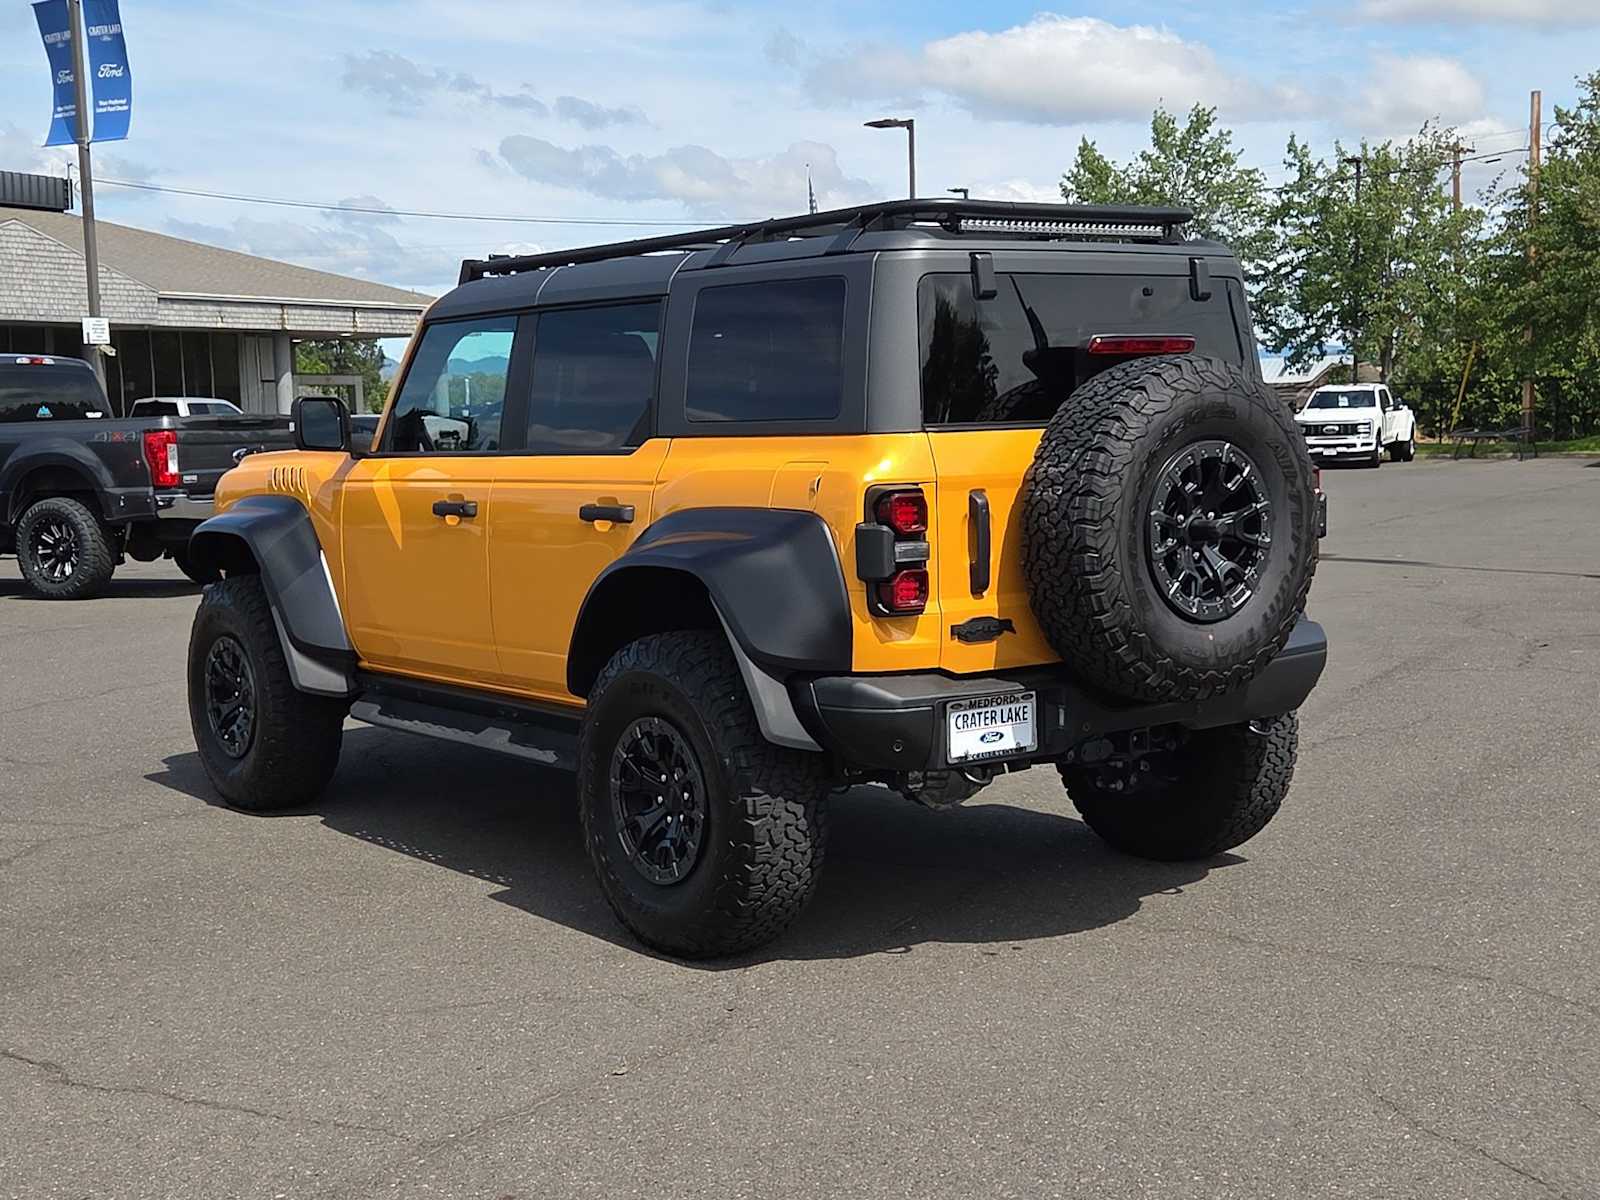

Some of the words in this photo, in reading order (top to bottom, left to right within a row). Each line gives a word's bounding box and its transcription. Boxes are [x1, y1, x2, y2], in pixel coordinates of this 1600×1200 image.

[98, 63, 124, 78] Ford
[969, 695, 1016, 709] MEDFORD
[955, 710, 998, 730] CRATER
[1000, 705, 1028, 724] LAKE
